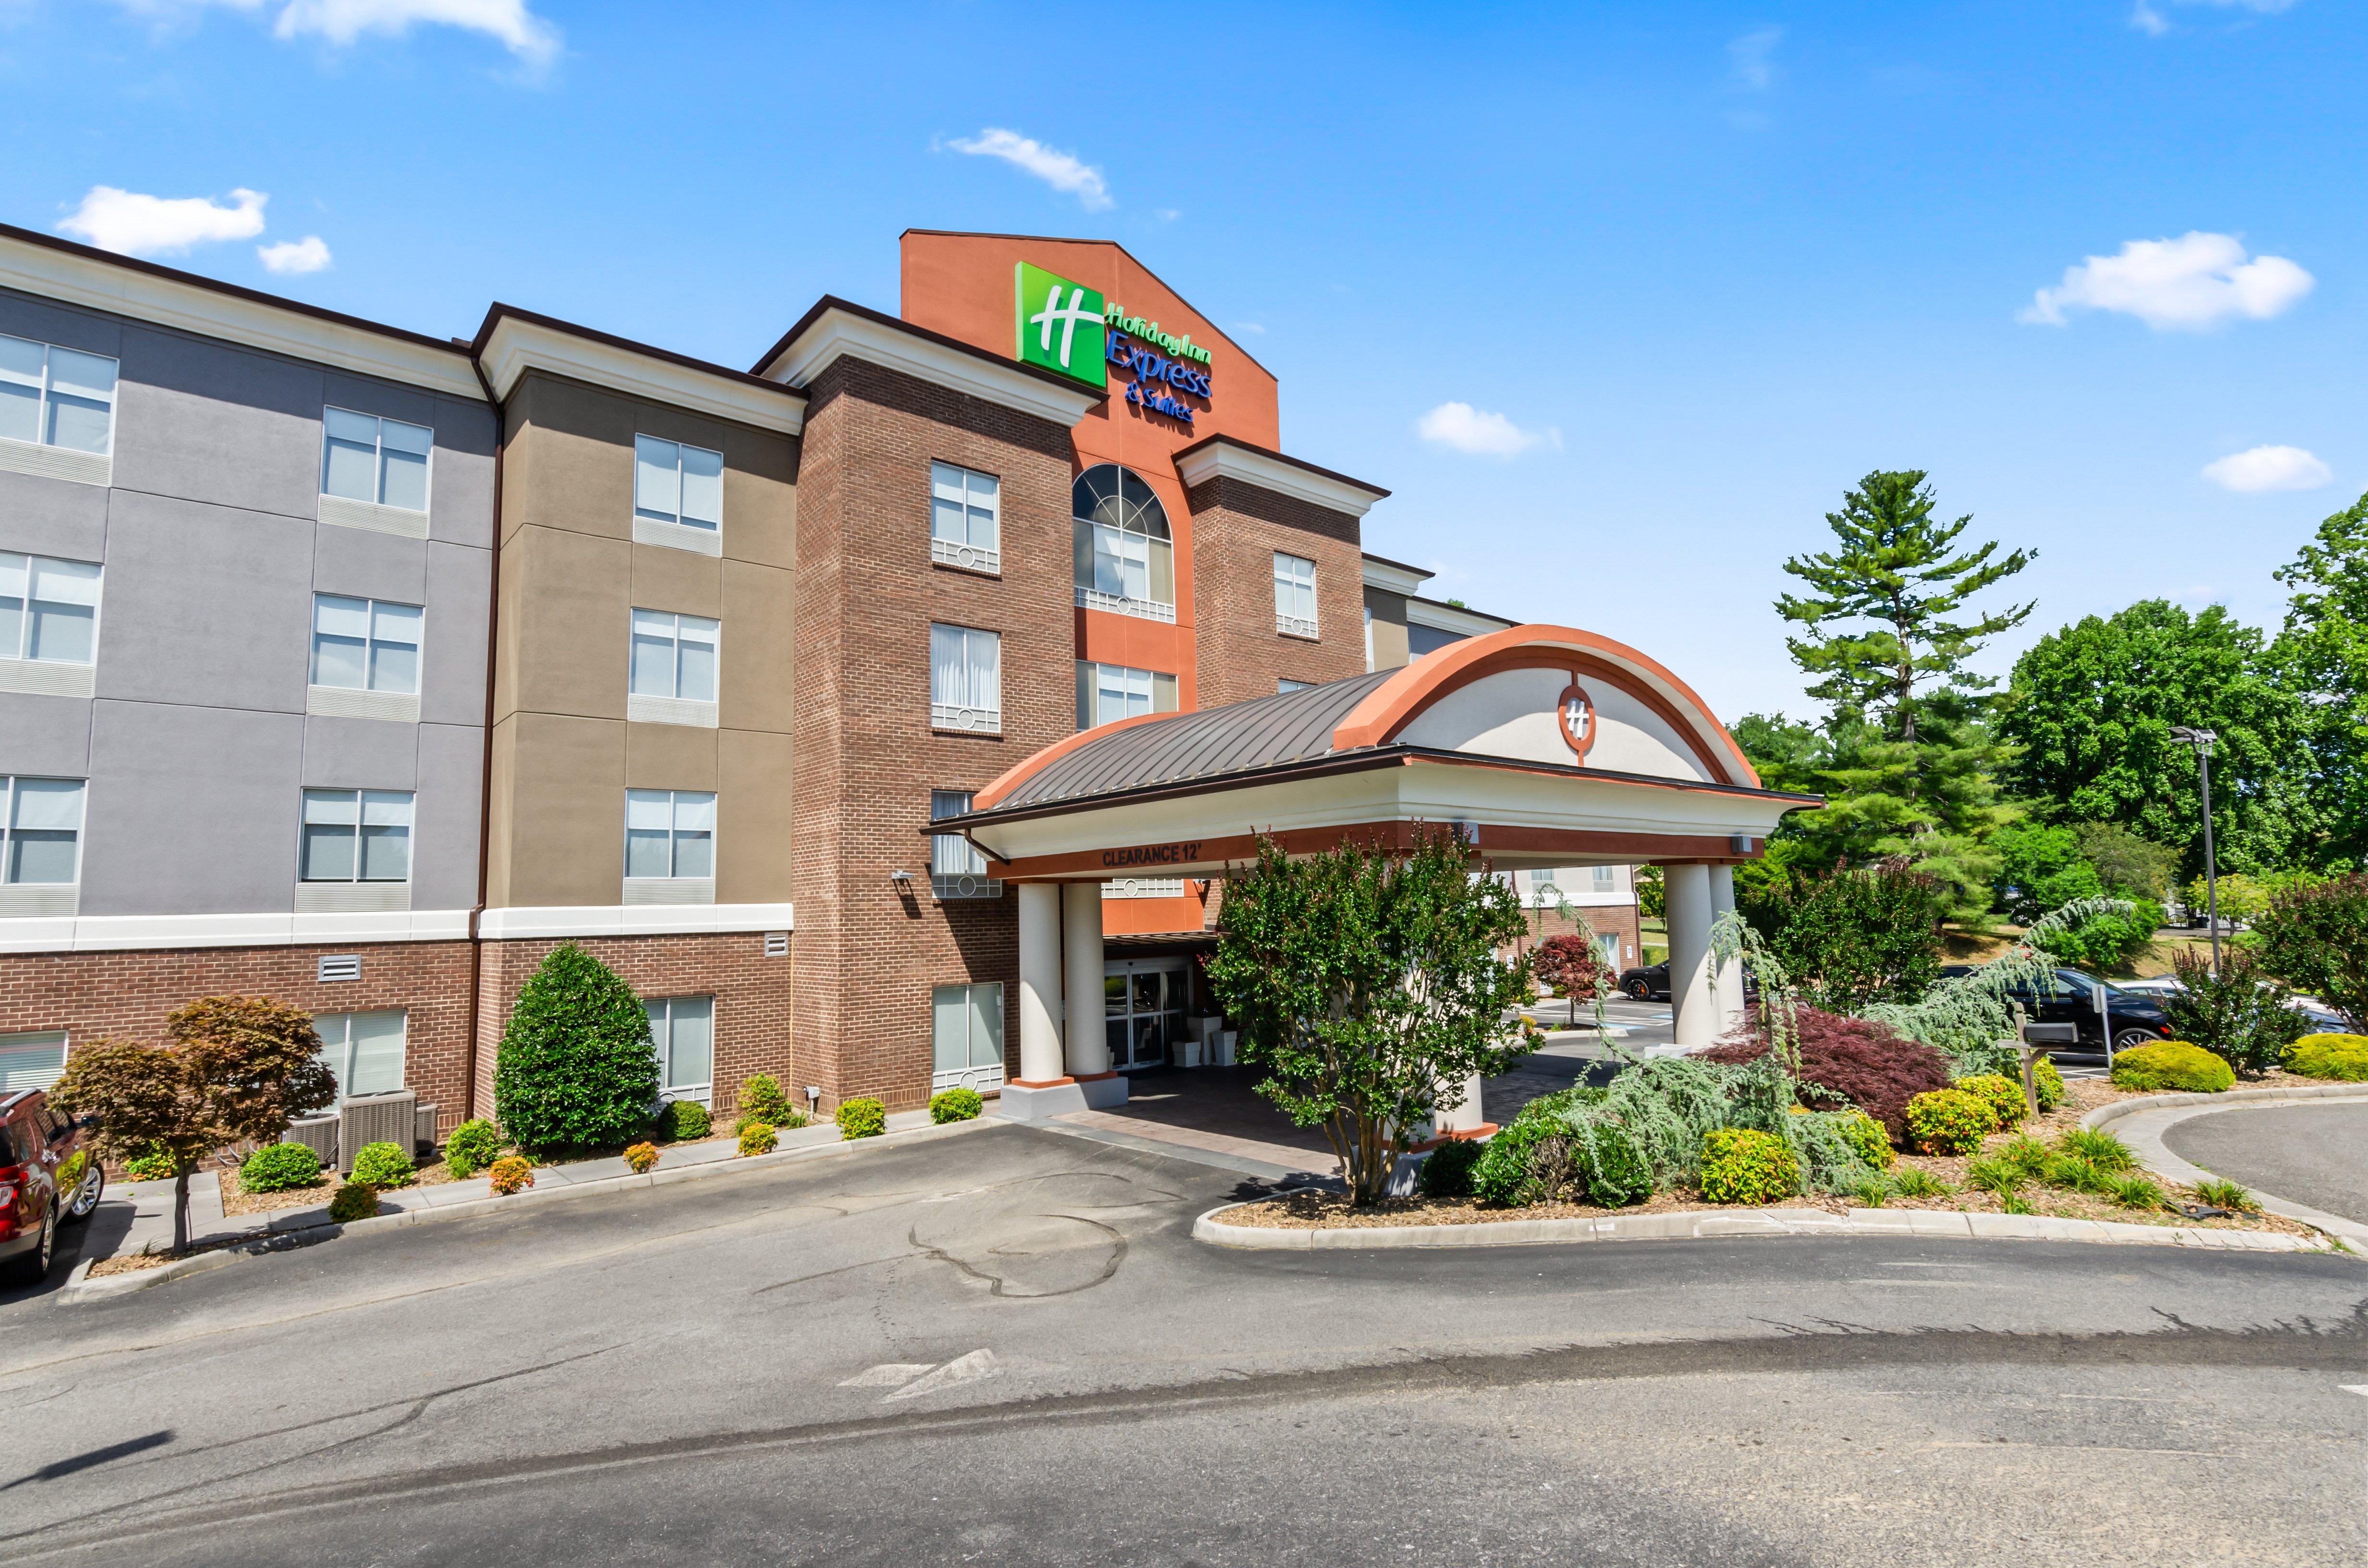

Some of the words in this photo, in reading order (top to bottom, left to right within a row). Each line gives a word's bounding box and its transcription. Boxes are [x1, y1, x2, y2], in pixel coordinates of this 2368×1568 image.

[1104, 302, 1181, 357] Holiday
[1180, 334, 1211, 365] Inn
[1106, 330, 1212, 398] Express
[1124, 382, 1140, 403] &
[1141, 388, 1194, 422] Suites
[1102, 845, 1180, 867] CLEARANCE
[1182, 843, 1201, 861] 12'
